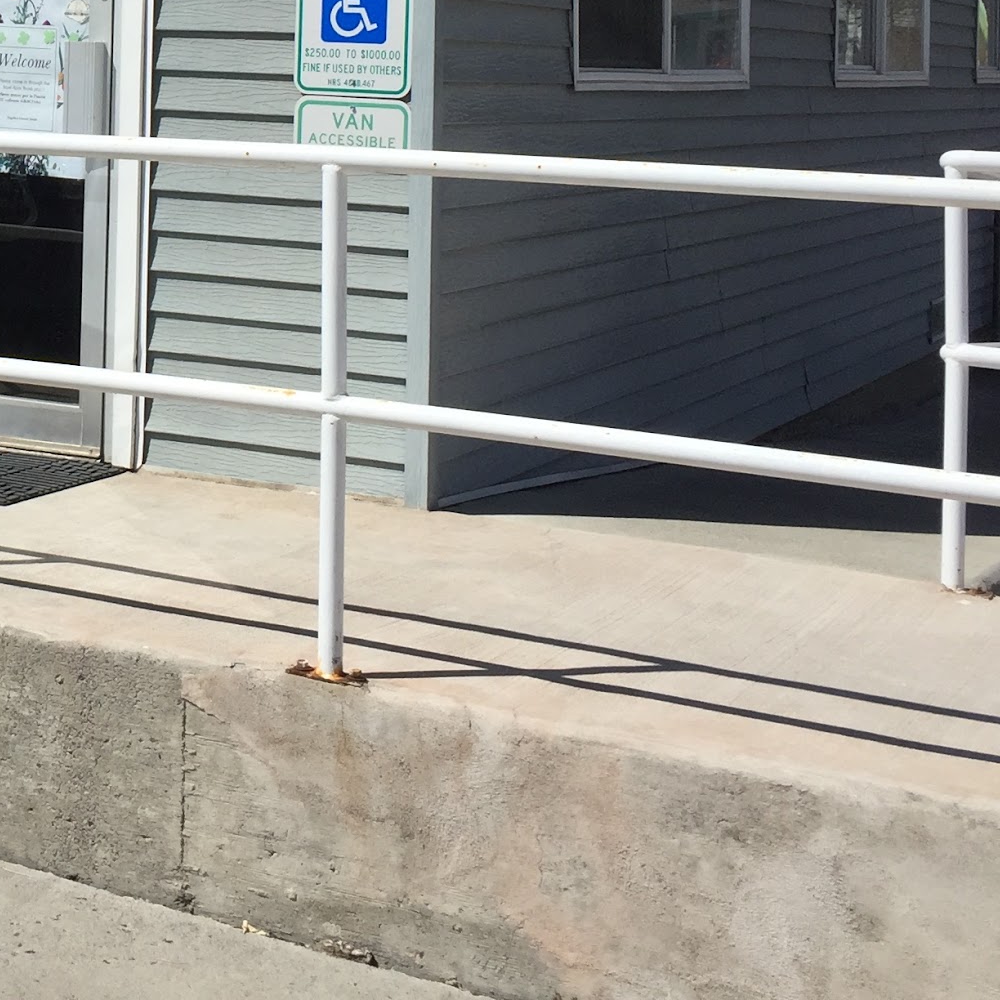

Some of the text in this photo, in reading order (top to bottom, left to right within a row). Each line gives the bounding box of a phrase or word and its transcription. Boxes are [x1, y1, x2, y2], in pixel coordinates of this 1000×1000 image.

[0, 53, 51, 69] Welcome
[305, 48, 401, 60] $250.00 TO $1000.00
[303, 62, 402, 76] FINE IF USED BY OTHERS
[332, 112, 374, 131] VAN
[308, 132, 396, 149] ACCESSIBLE
